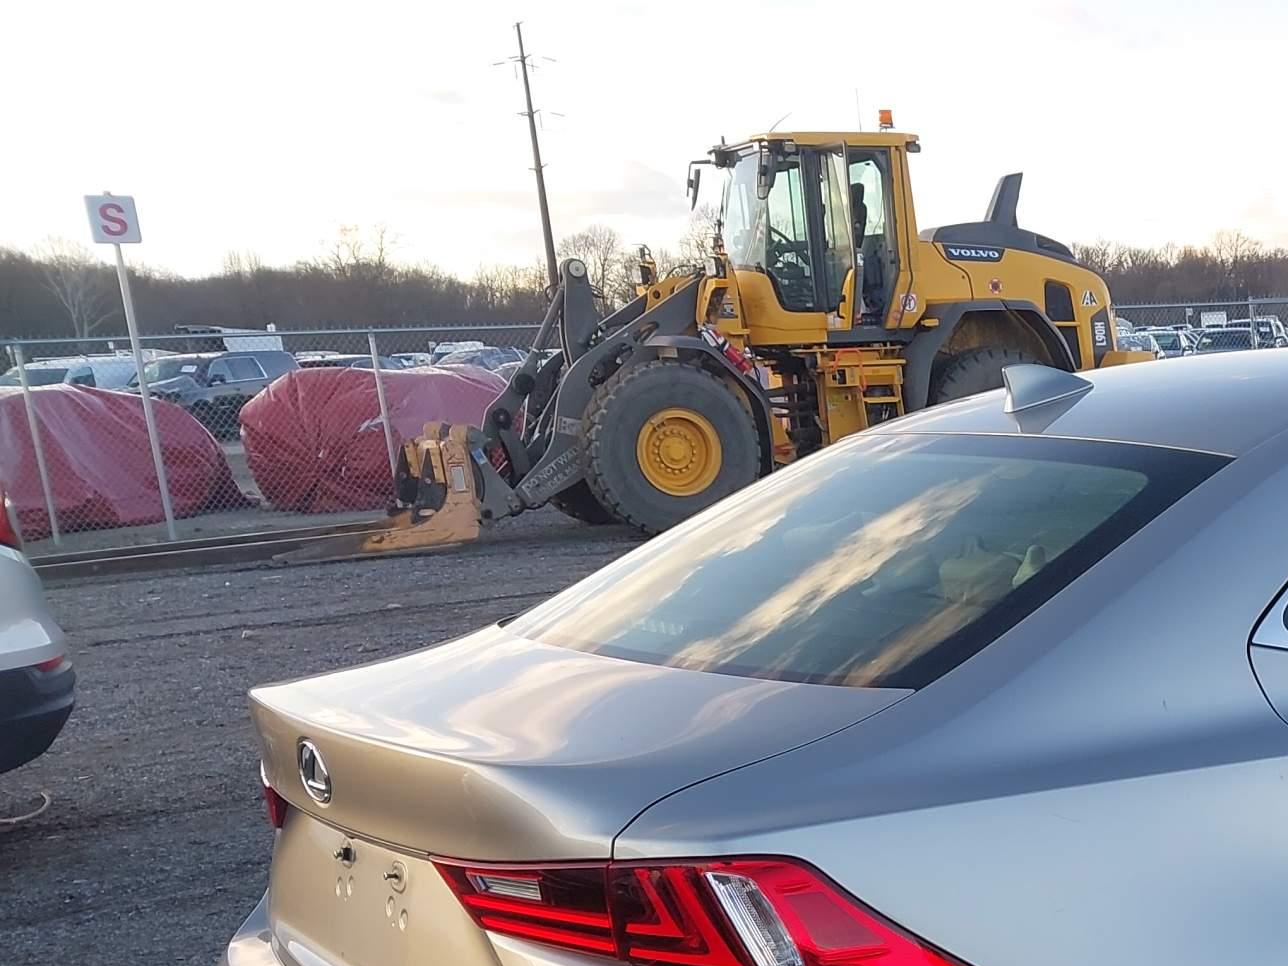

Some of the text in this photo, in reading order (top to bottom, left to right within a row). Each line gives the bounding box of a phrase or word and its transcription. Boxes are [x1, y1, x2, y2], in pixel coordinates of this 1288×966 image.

[99, 203, 128, 236] S
[948, 248, 999, 258] VOLVO
[1094, 321, 1107, 346] L90H
